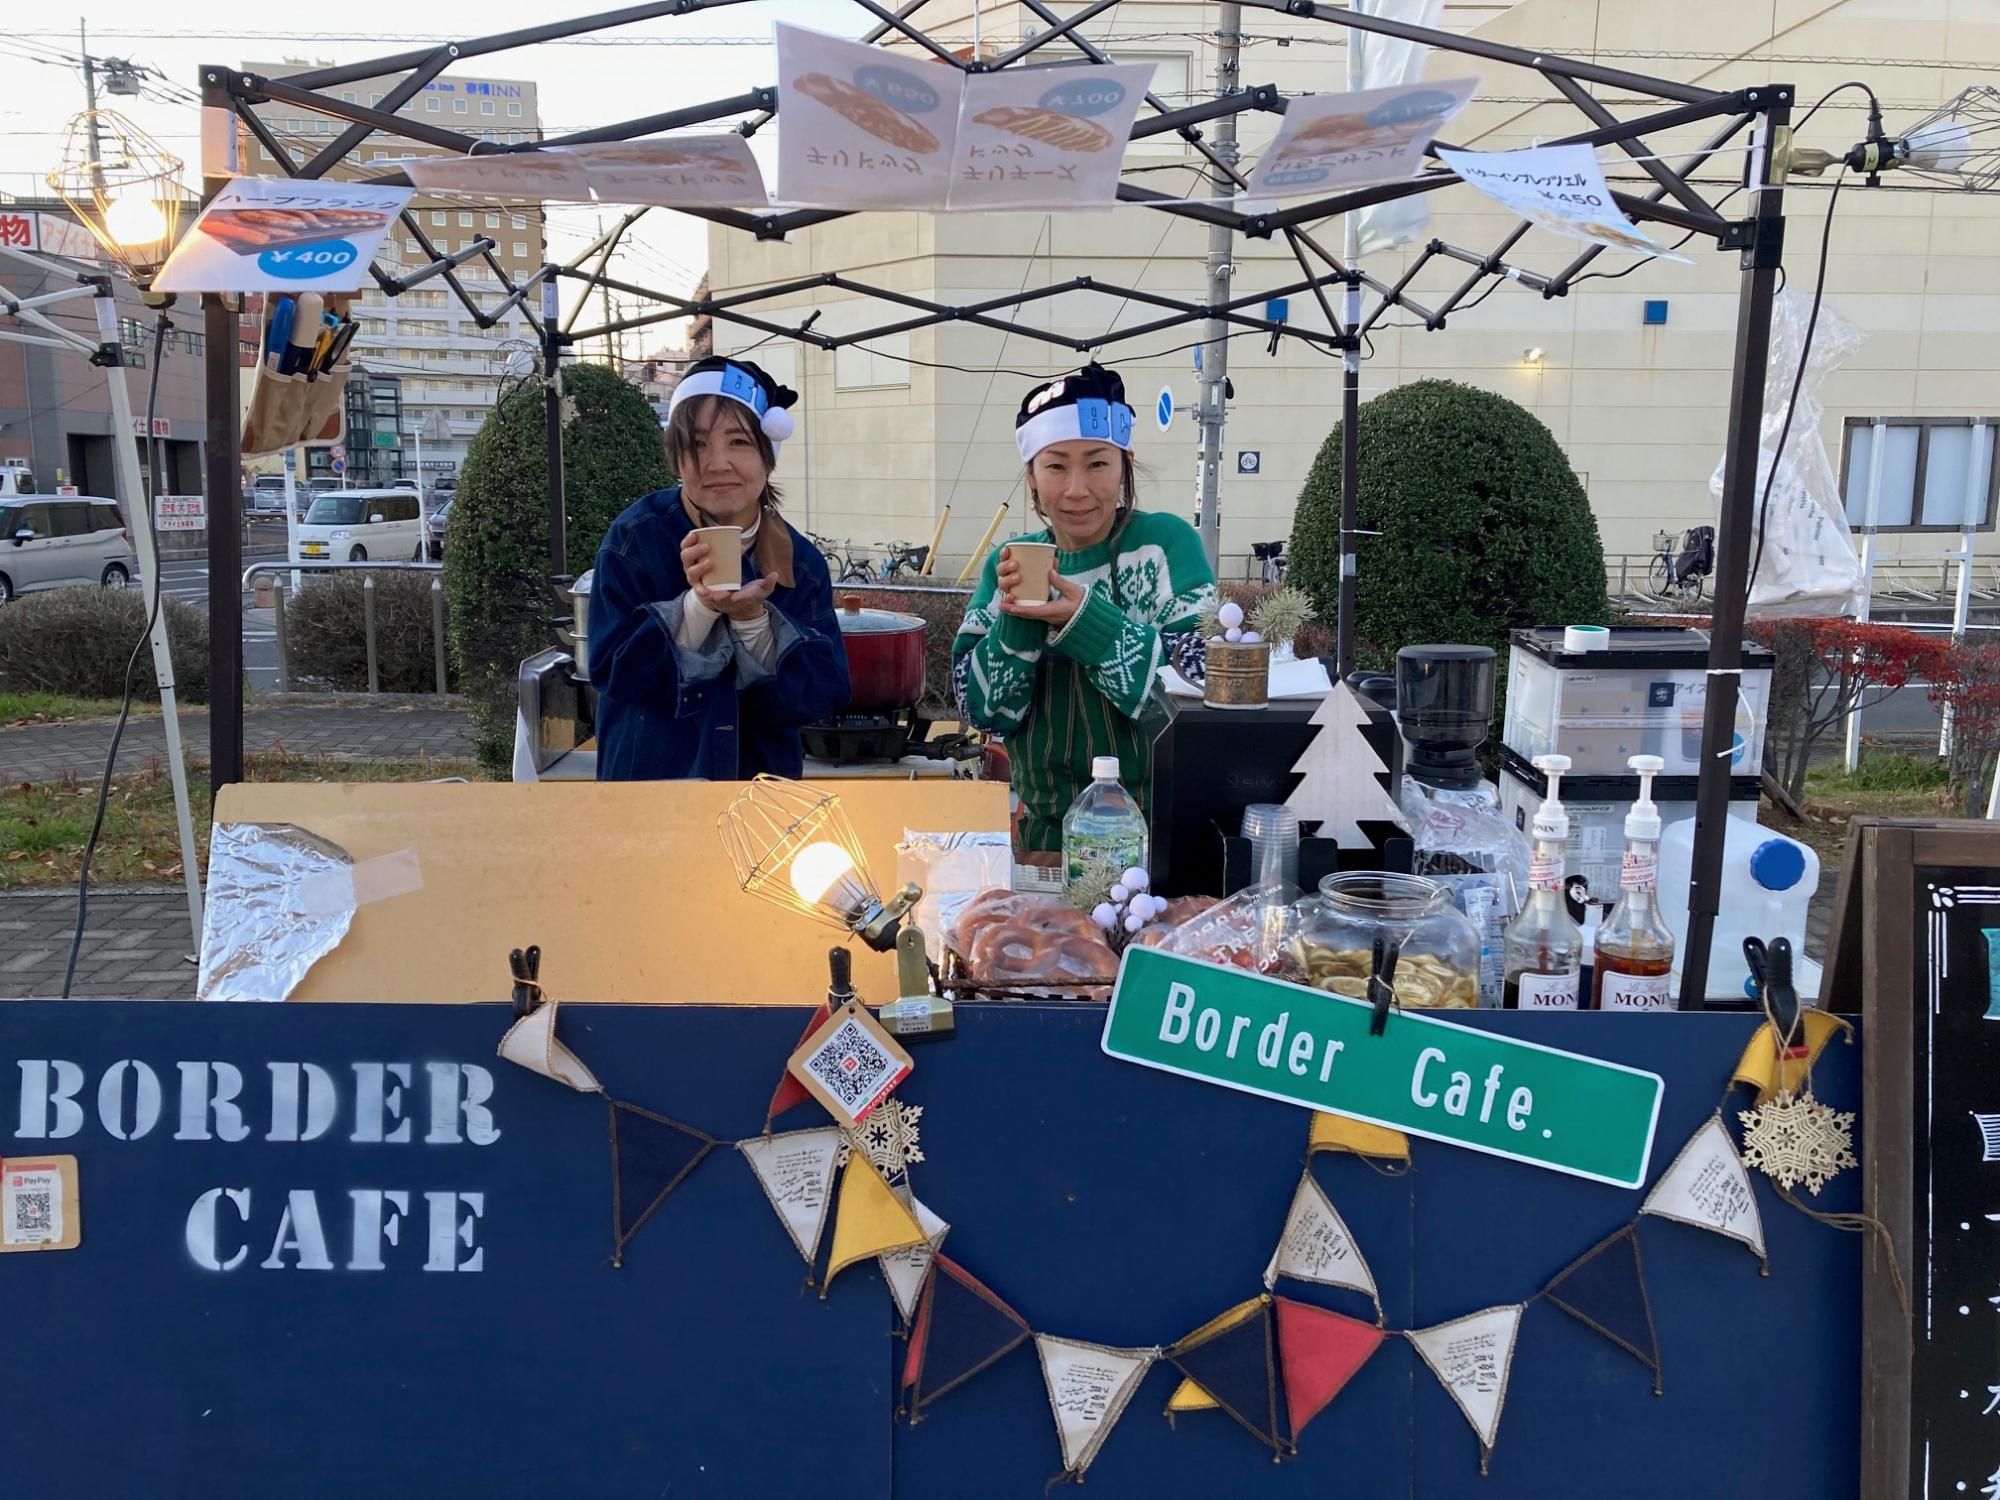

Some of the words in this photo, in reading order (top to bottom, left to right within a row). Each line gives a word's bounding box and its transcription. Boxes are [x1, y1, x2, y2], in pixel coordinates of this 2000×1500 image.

[0, 214, 31, 247] 物
[1533, 993, 1578, 1006] MON
[1158, 980, 1344, 1083] Border
[1411, 1047, 1553, 1139] Cafe.
[13, 1058, 501, 1146] BORDER
[24, 1177, 50, 1185] PayPay
[185, 1186, 485, 1272] CAFE
